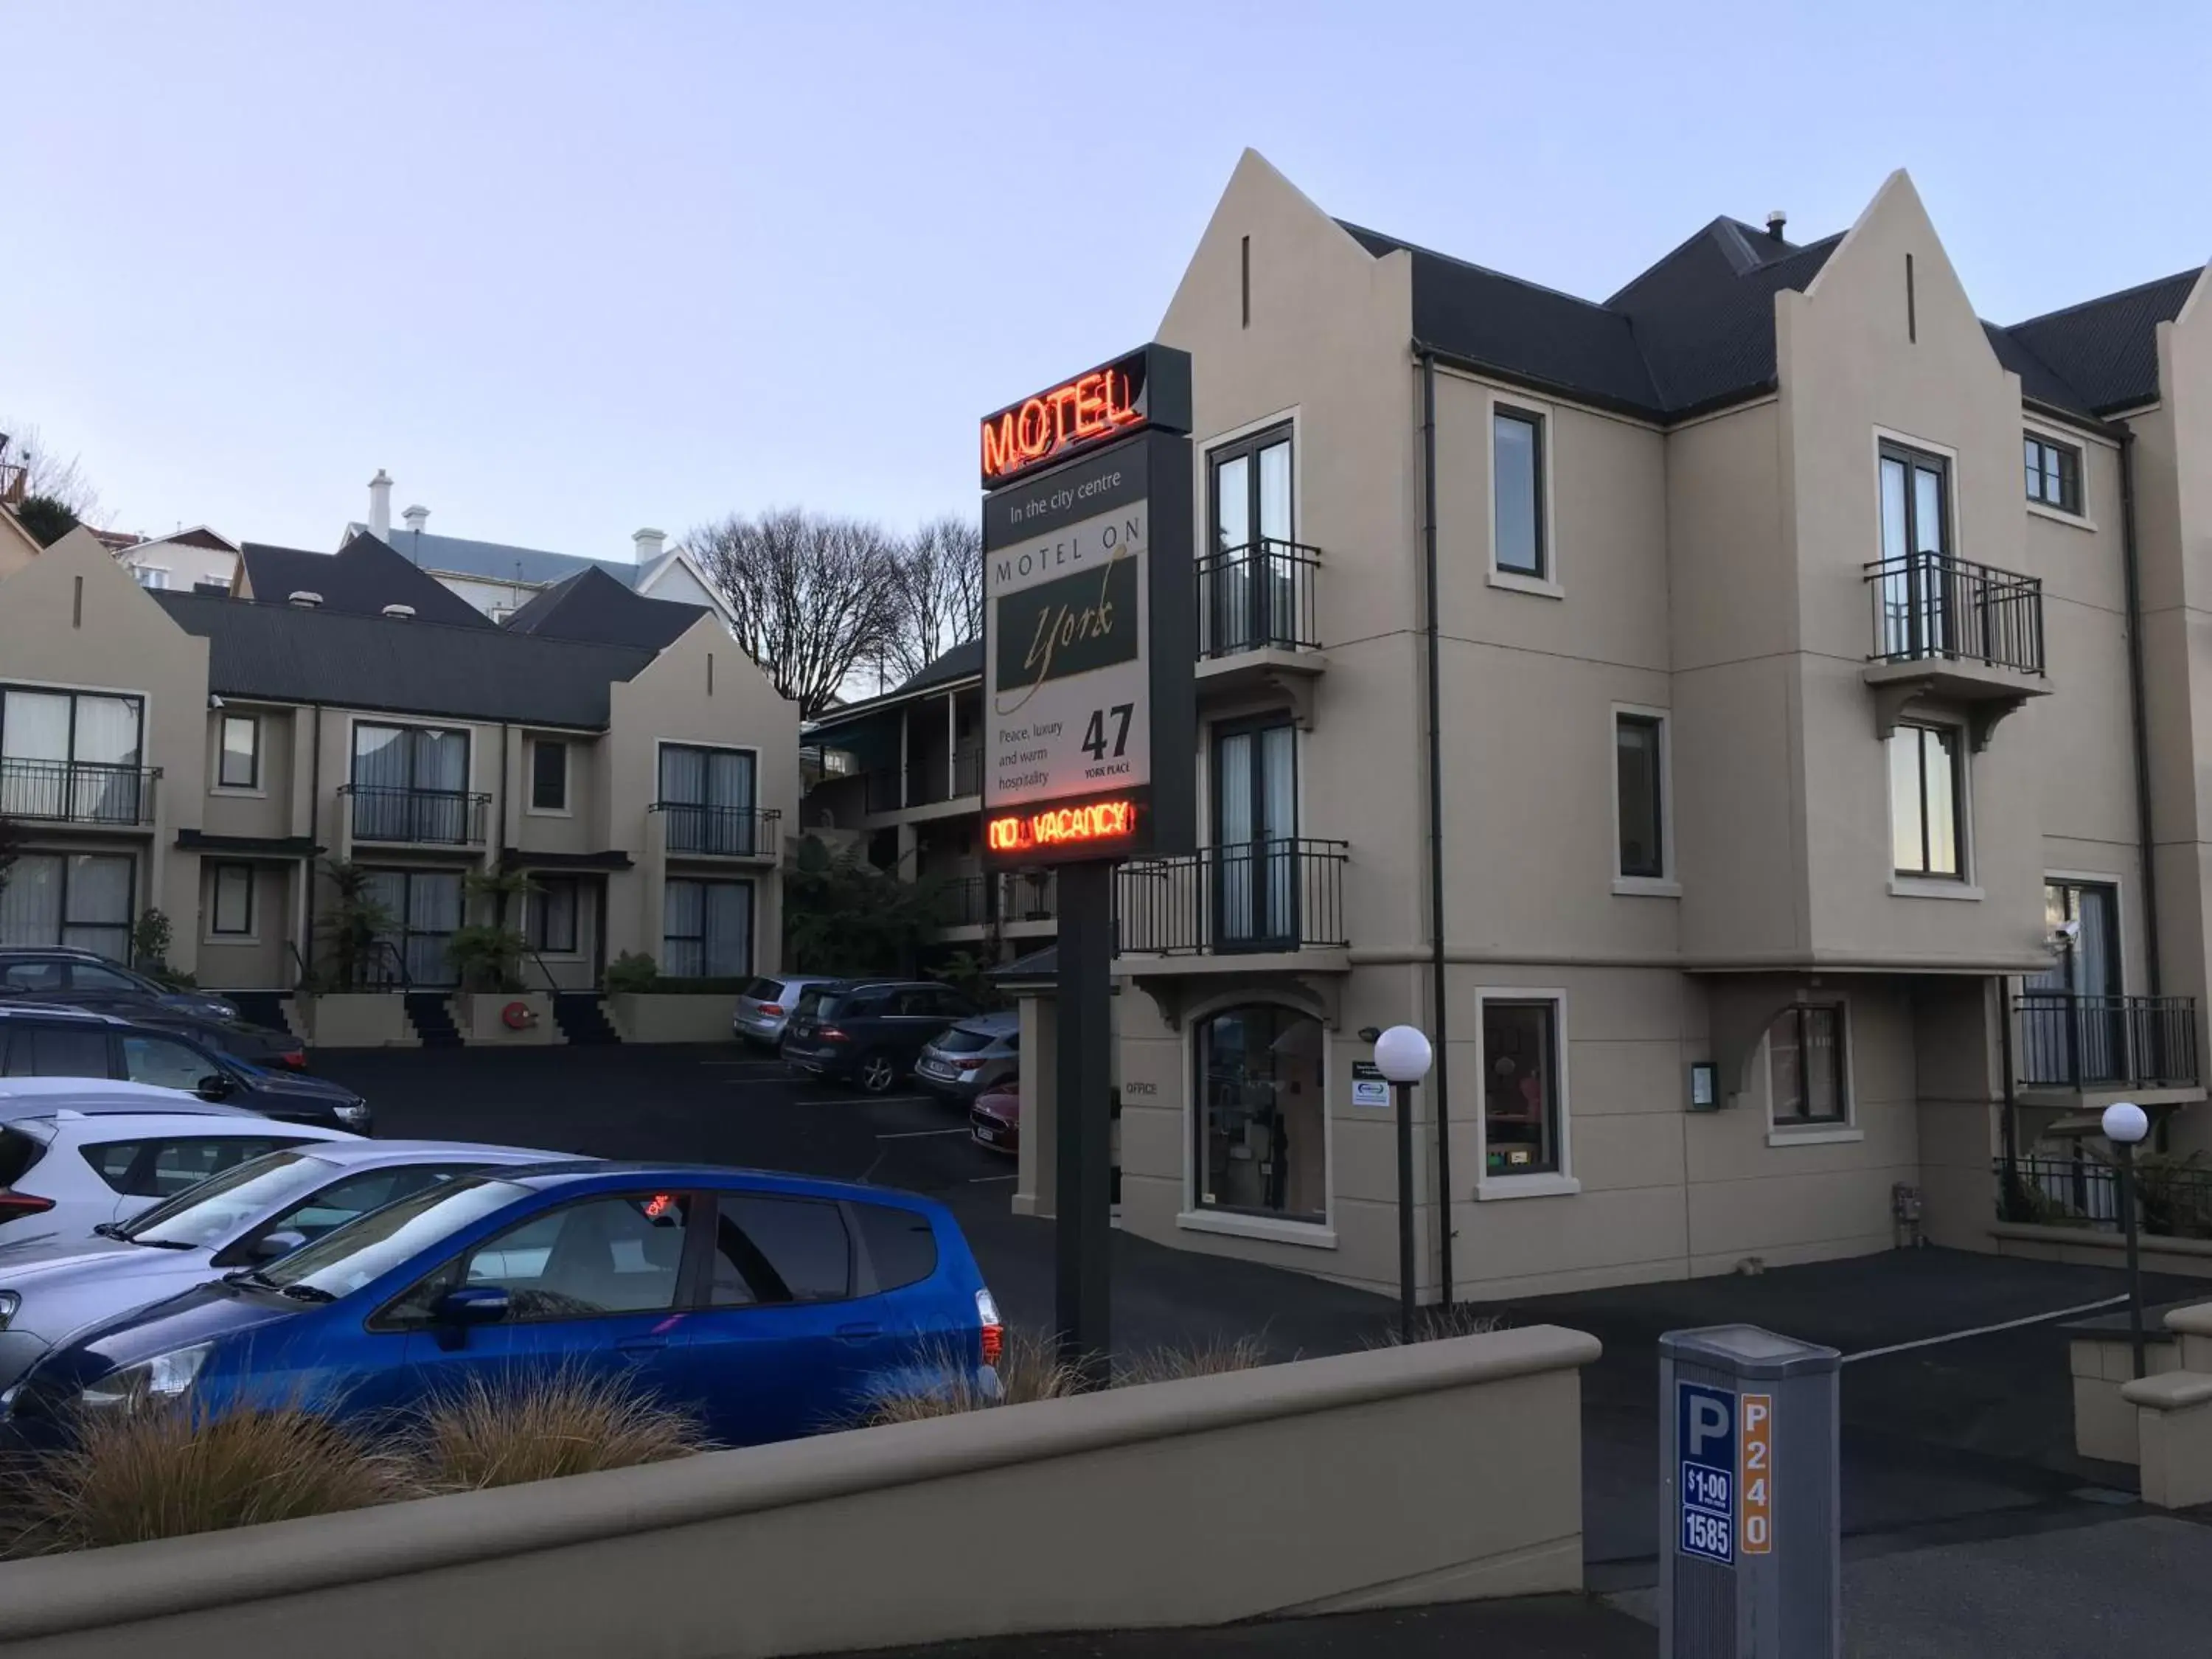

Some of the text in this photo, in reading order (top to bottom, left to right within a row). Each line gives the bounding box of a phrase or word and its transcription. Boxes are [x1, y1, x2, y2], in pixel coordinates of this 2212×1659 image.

[983, 369, 1134, 474] MOTEL
[1010, 472, 1121, 524] In the city centre
[996, 517, 1139, 585] MOTEL ON
[999, 720, 1063, 745] Peace, luxury
[1081, 702, 1135, 761] 47
[999, 748, 1048, 767] and warm
[1085, 761, 1130, 779] YORK PLACE
[999, 771, 1049, 791] hospitality
[990, 801, 1129, 849] NO VACANCY
[1126, 1082, 1157, 1096] OFFICE
[1690, 1394, 1729, 1455] P
[1686, 1512, 1728, 1555] 1585
